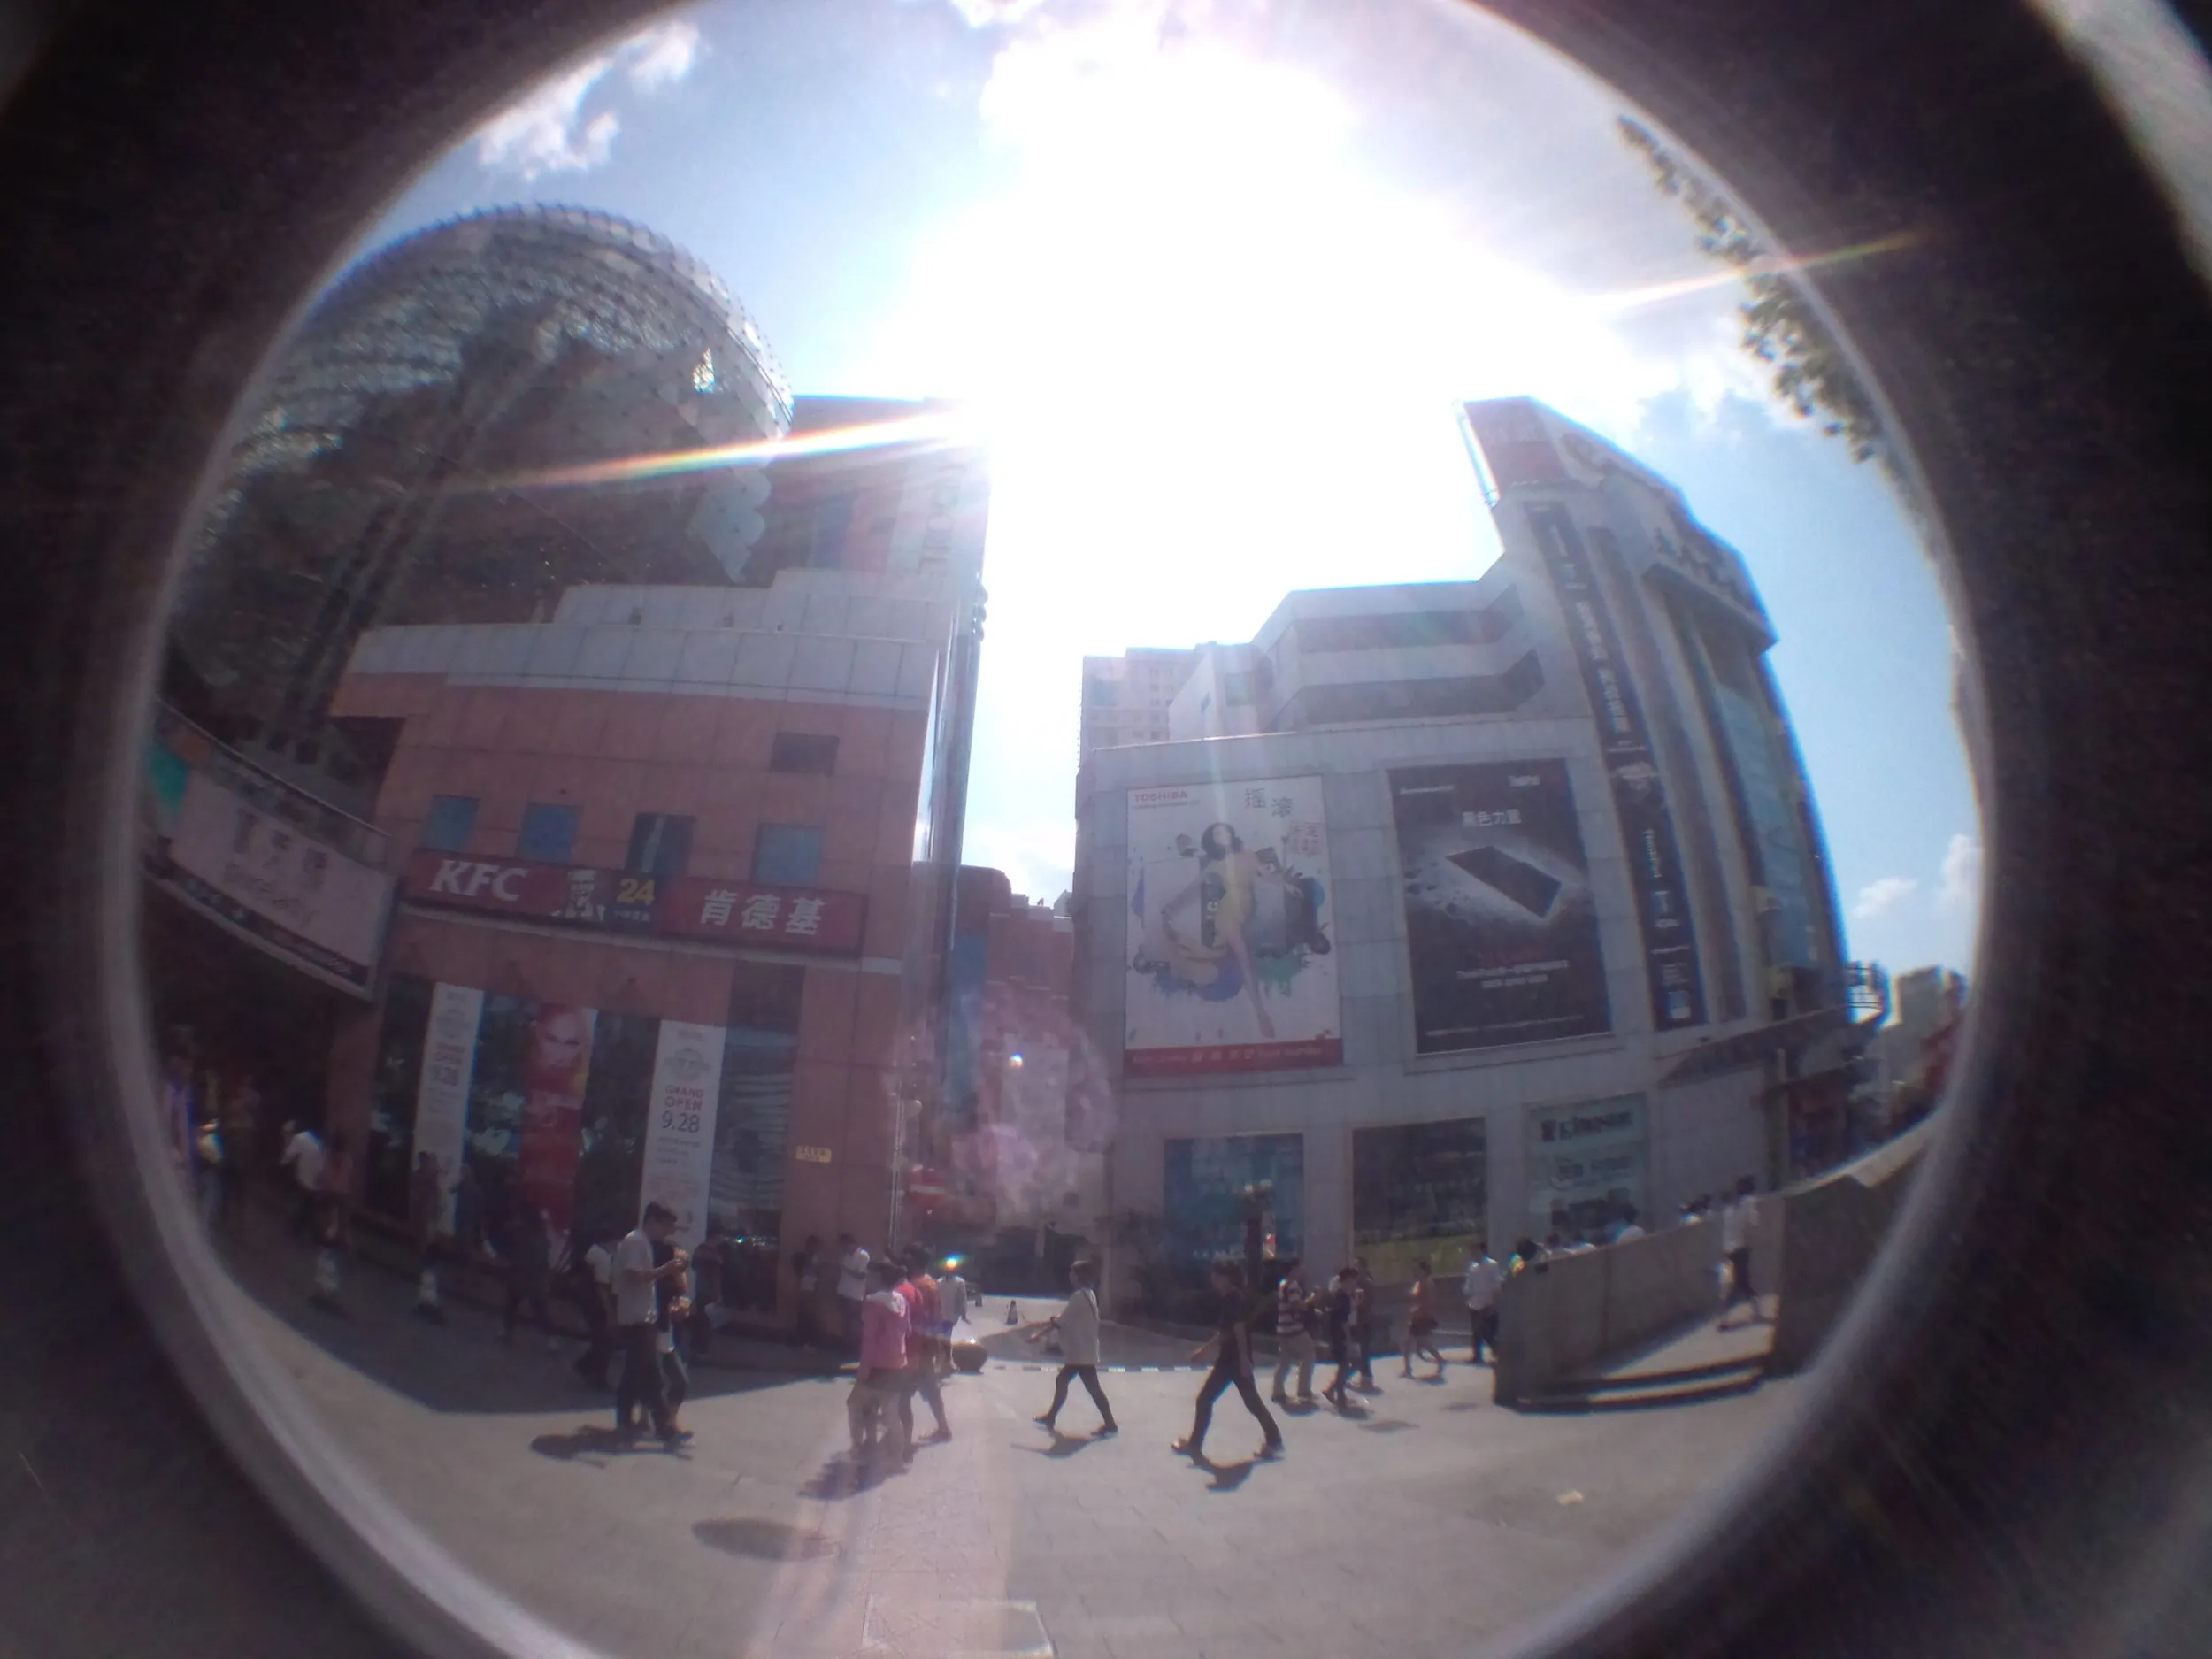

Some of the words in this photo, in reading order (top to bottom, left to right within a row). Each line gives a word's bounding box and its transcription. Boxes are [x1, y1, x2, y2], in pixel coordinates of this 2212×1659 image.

[1133, 790, 1188, 803] TOSHIBA
[428, 859, 528, 902] KFC
[617, 878, 656, 906] 24
[700, 888, 826, 935] 肯德基
[665, 1085, 704, 1098] GRAND
[664, 1096, 703, 1112] OPEN
[662, 1110, 700, 1133] 9.28
